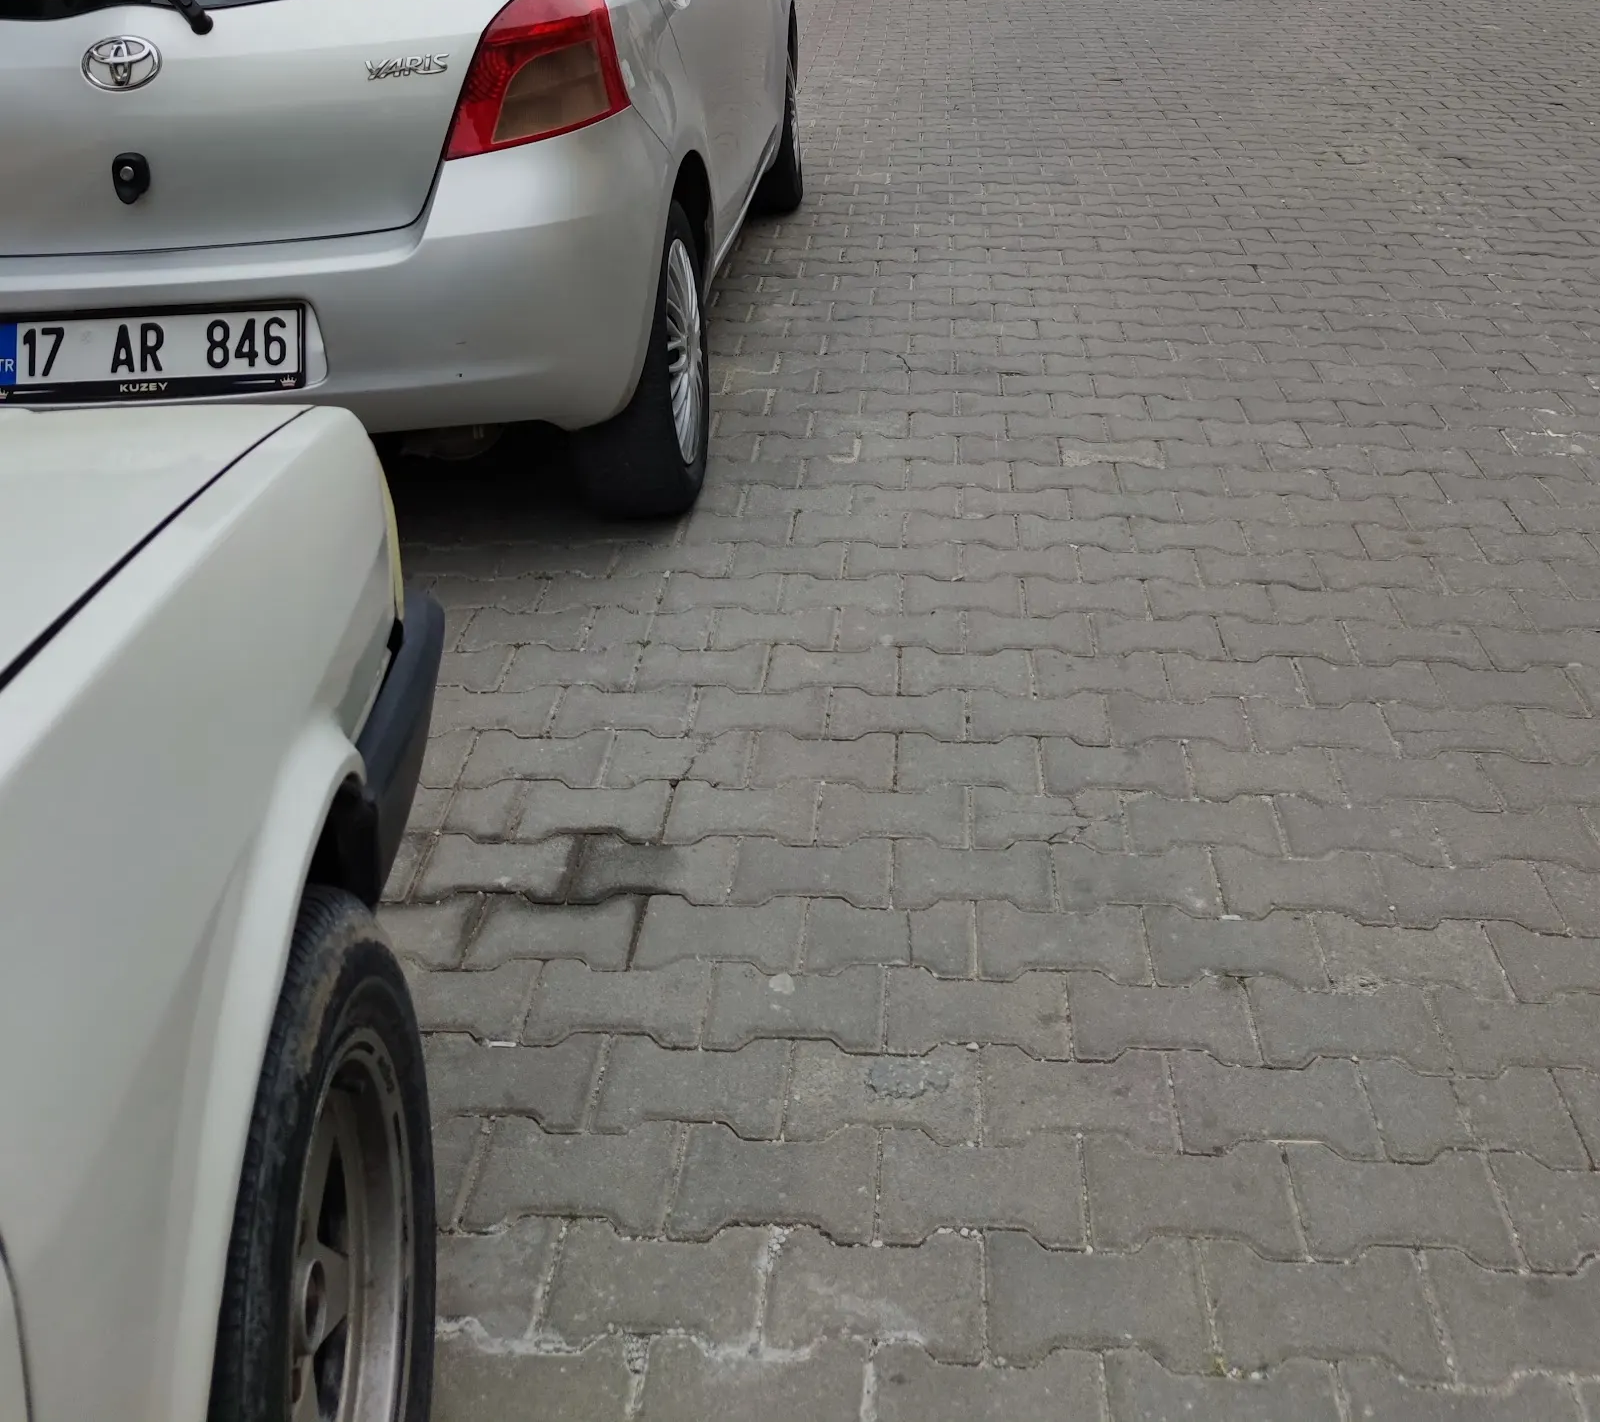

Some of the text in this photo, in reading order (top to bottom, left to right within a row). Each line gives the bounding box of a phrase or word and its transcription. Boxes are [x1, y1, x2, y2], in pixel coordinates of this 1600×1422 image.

[23, 316, 287, 377] 17 AR 846
[119, 381, 169, 394] KUZEY
